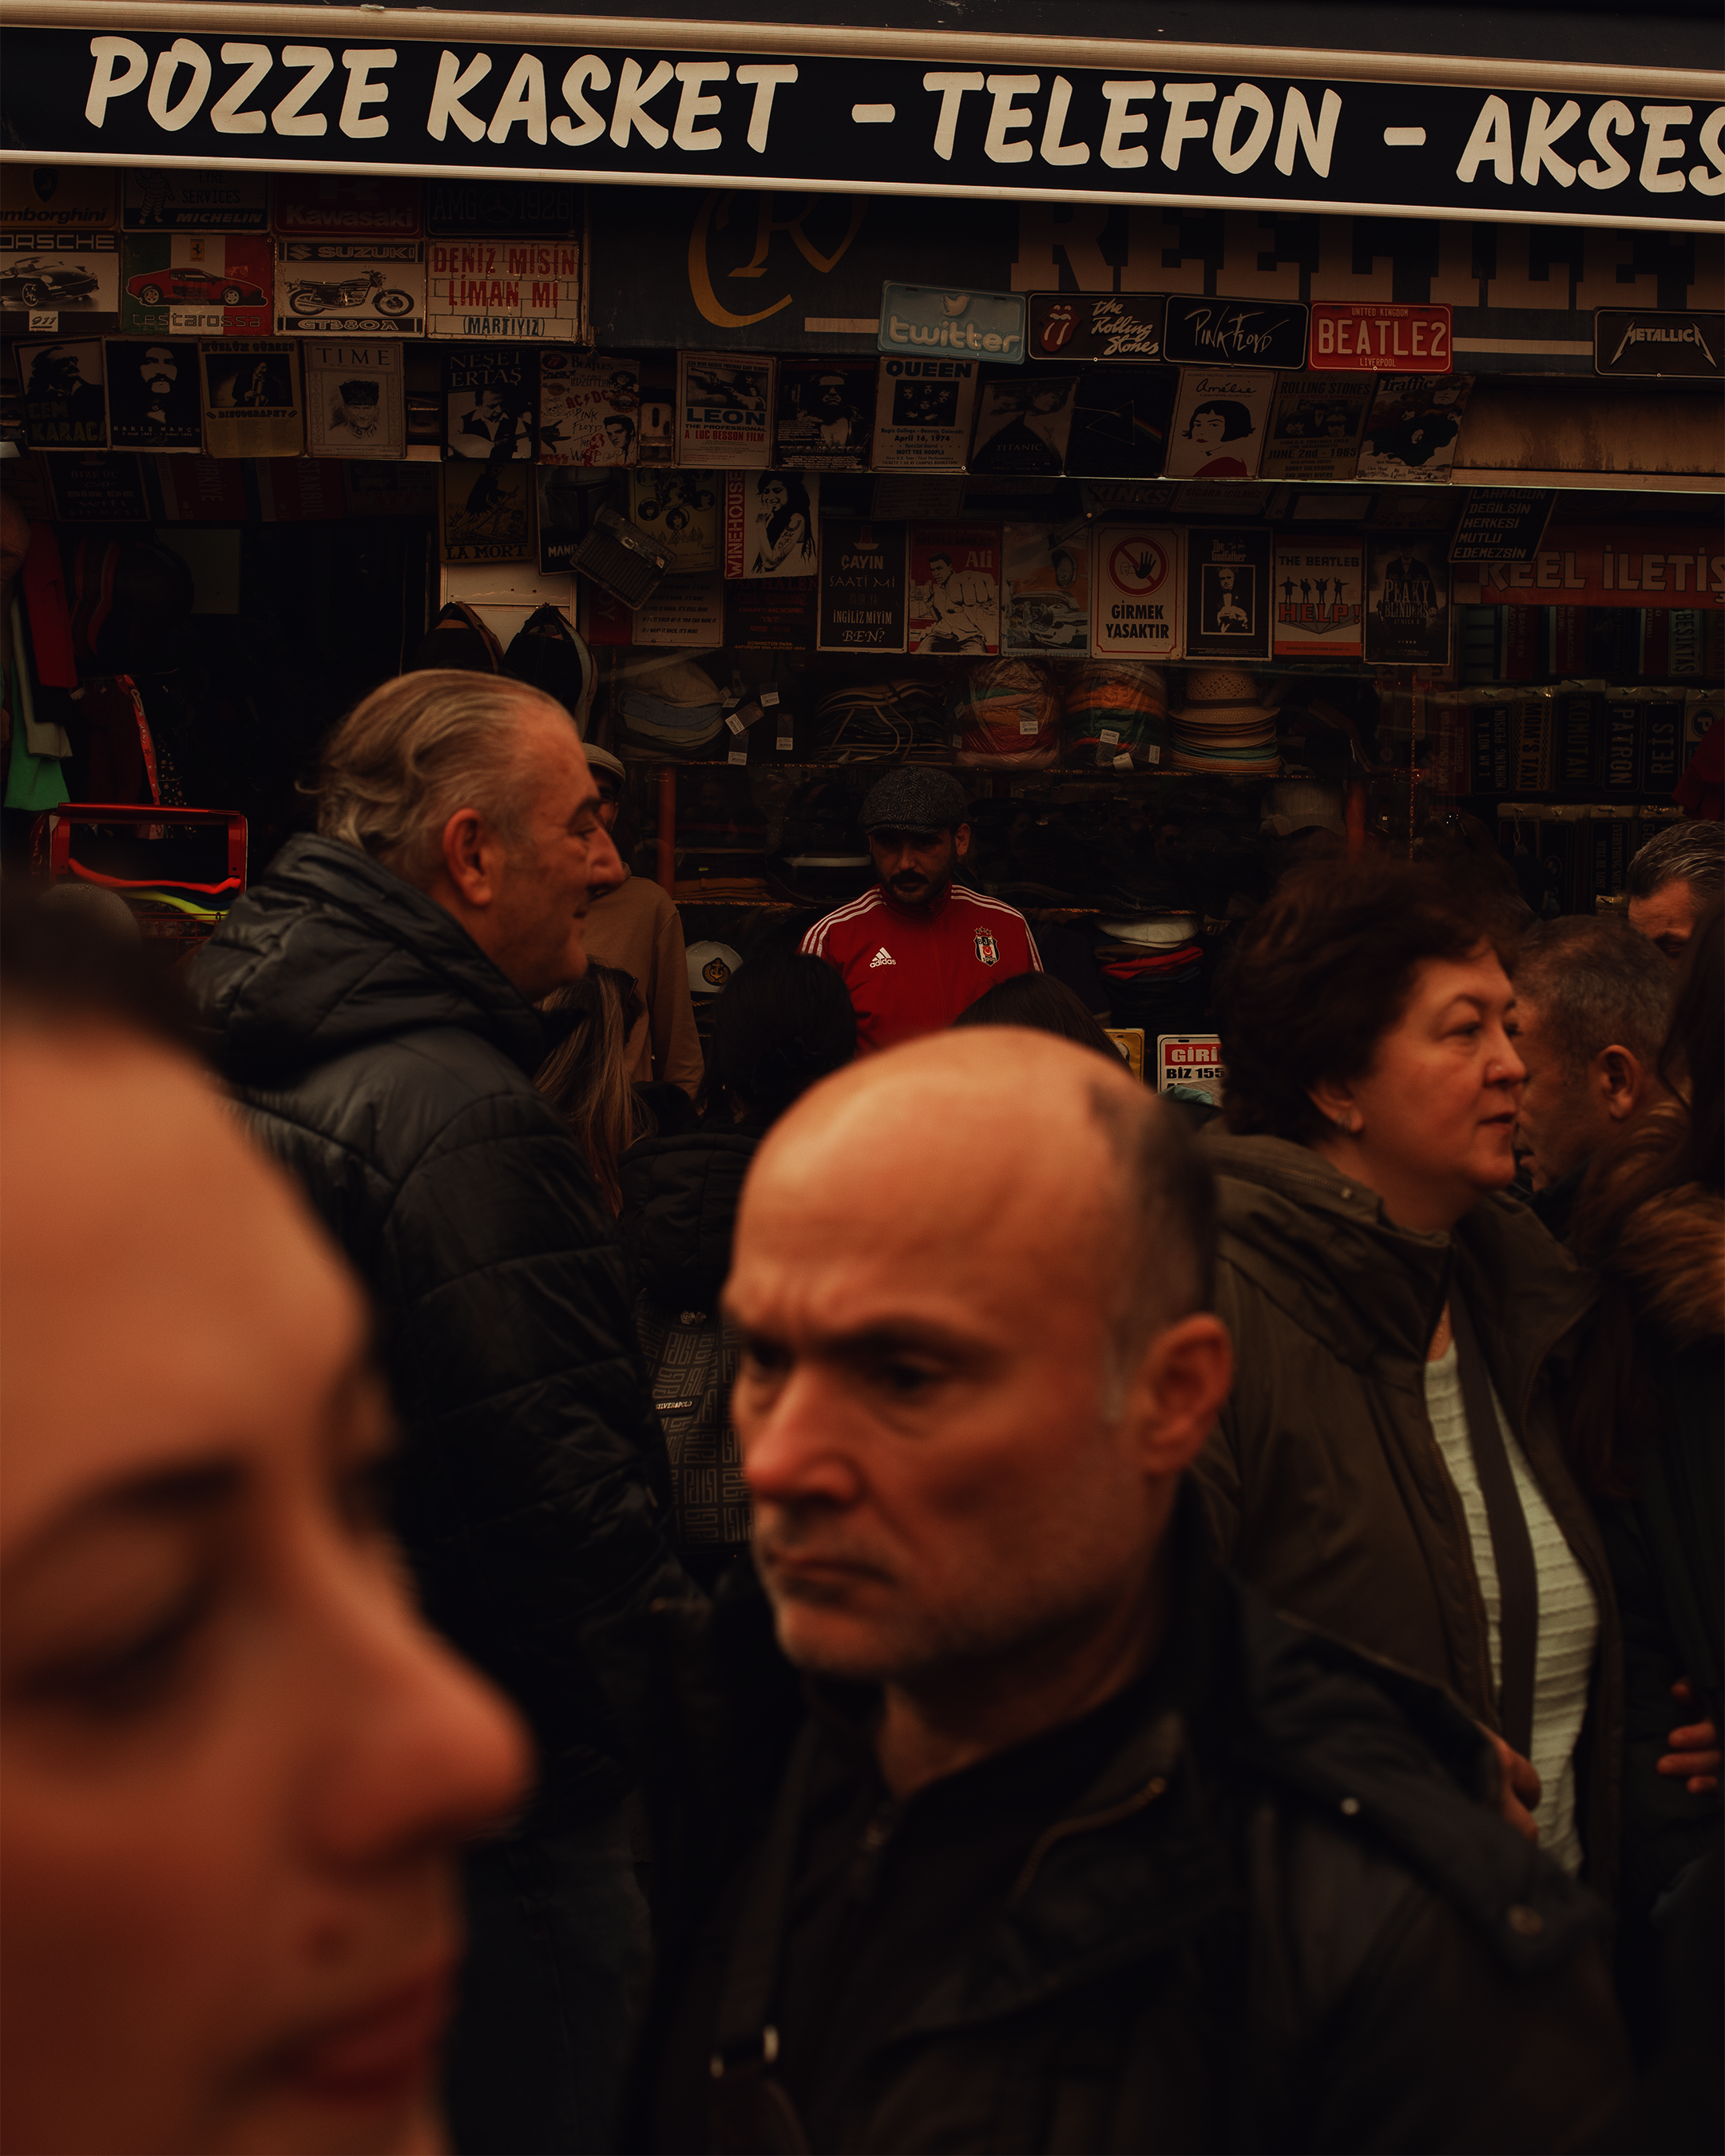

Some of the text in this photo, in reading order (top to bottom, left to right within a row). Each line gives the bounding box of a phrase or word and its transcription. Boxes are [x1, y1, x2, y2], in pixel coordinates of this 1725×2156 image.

[85, 35, 398, 140] POZZE
[426, 50, 799, 154] KASKET
[922, 71, 1342, 179] TELEFON
[182, 190, 240, 204] SERVICES
[433, 188, 569, 220] AMG 1926
[176, 213, 263, 224] MICHELIN
[286, 204, 414, 228] Kawasaki
[318, 246, 415, 259] SUZUKI
[434, 243, 574, 275] DENİZ MİSİN
[449, 274, 558, 307] LİMAN MI
[1091, 298, 1124, 316] the
[1351, 307, 1409, 317] UNITED KINGDOM
[131, 312, 260, 328] testarossa
[297, 319, 399, 331] GT380A
[889, 315, 1020, 353] twitter
[1091, 315, 1153, 342] Rolling
[1103, 334, 1160, 355] Stones
[1319, 319, 1446, 356] BEATLE2
[1610, 319, 1718, 369] METALLICA
[315, 348, 391, 366] TIME
[450, 351, 525, 370] NEŞET
[1359, 358, 1396, 367] LIVERPOOL
[451, 367, 522, 386] ERTAŞ
[886, 360, 972, 378] QUEEN
[1318, 372, 1339, 382] The
[1196, 378, 1257, 394] Amélie
[1279, 382, 1371, 395] ROLLING STONES
[1382, 376, 1434, 391] Traffic
[29, 401, 68, 419] CEM
[687, 408, 765, 426] LEON
[684, 430, 764, 442] A LUC BESSON FILM
[541, 454, 569, 465] KISS
[1267, 448, 1357, 459] JUNE 2nd 1965
[1185, 487, 1221, 498] SİGARA
[1468, 501, 1531, 514] DEĞİLSİN
[728, 470, 744, 577] WINEHOUSE
[1463, 517, 1520, 529] HERKESİ
[916, 537, 996, 546] MUHAMMAD
[1212, 539, 1225, 552] The
[1458, 533, 1503, 543] MUTLU
[446, 544, 527, 560] LA MORT
[965, 550, 993, 568] Ali
[1211, 550, 1247, 562] Godfather
[1453, 546, 1527, 559] EDEMEZSİN
[841, 554, 884, 570] ÇAYIN
[1279, 556, 1359, 567] THE BEATLES
[830, 575, 895, 588] SAATİ Mİ
[850, 593, 878, 605] OLUR YA
[1384, 579, 1430, 604] PEAKY
[833, 609, 892, 624] İNGİLİZ MİYİM
[1112, 600, 1164, 620] GİRMEK
[1278, 603, 1361, 624] HELP!
[1385, 602, 1429, 618] BLINDERS
[842, 628, 885, 643] BEN?
[1105, 624, 1169, 639] YASAKTIR
[1672, 613, 1697, 672] BEŞİKTAŞ
[1520, 703, 1544, 789] MOM'S TAXI
[1565, 699, 1592, 779] KOMUTAN
[1609, 707, 1636, 785] PATRON
[1493, 710, 1507, 788] MORNING PERSON
[1648, 723, 1675, 775] REİS
[1611, 824, 1622, 883] EVERYTHING NOT
[1596, 841, 1606, 889] WILL BE LOST
[870, 957, 897, 968] adidas
[1166, 1067, 1192, 1079] BİZ
